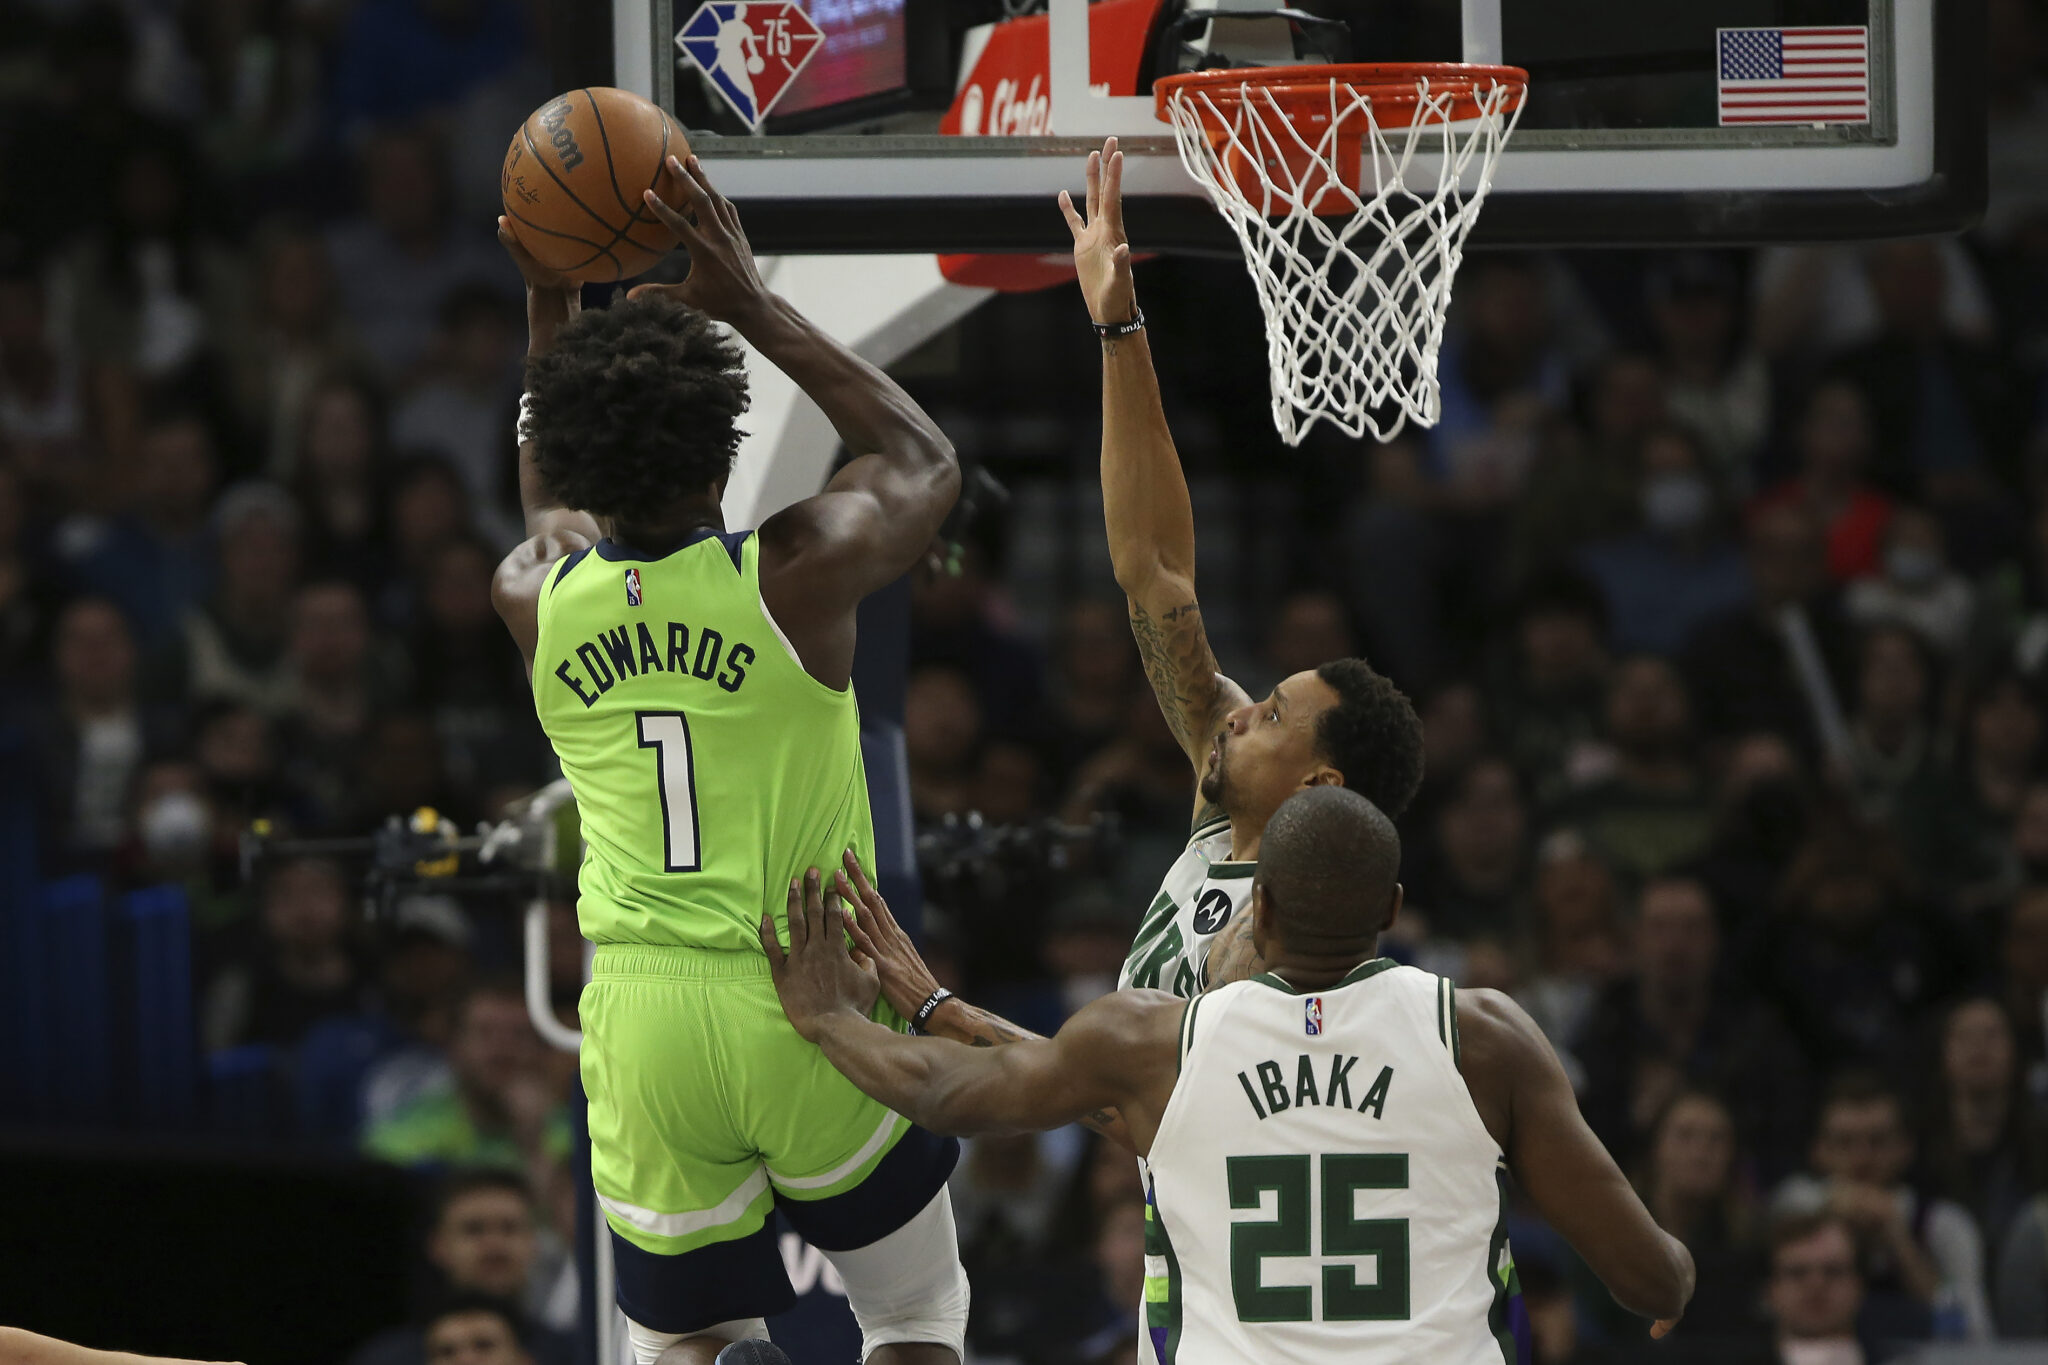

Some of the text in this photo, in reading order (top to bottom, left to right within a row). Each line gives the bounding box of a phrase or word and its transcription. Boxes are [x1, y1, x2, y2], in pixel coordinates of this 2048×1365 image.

[763, 19, 791, 56] 75
[554, 621, 756, 709] EDWARDS
[635, 711, 702, 873] 1
[919, 999, 938, 1018] True
[1237, 1054, 1394, 1120] IBAKA
[1226, 1152, 1410, 1322] 25
